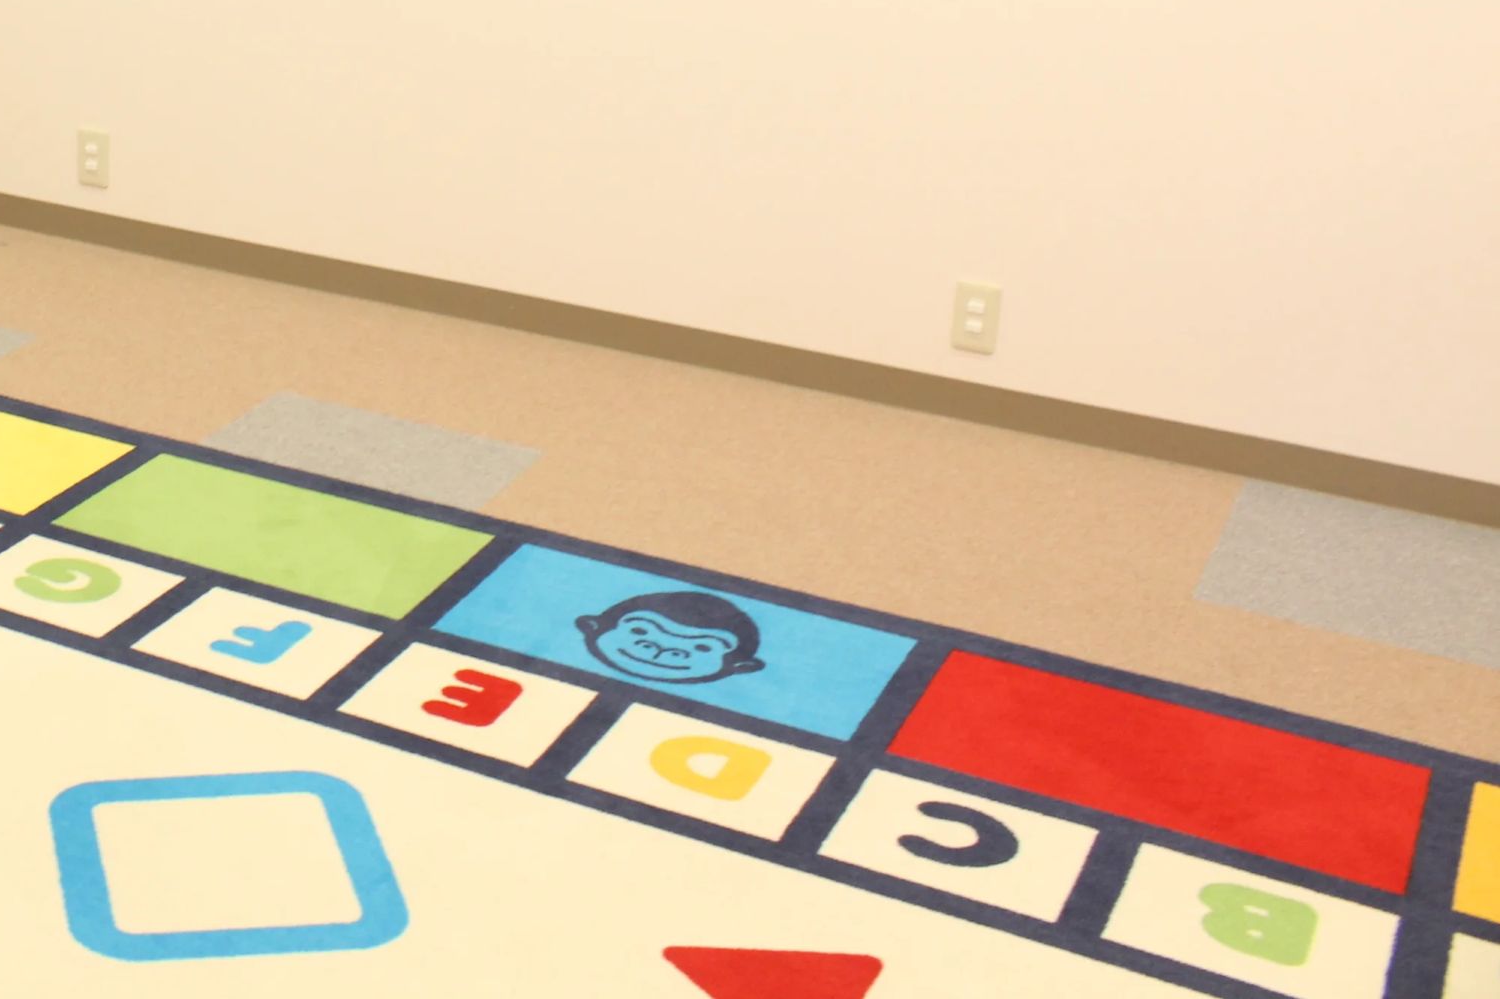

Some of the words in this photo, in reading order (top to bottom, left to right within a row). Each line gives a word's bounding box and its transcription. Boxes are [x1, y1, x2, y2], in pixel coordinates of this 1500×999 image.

[16, 558, 122, 603] G
[210, 621, 311, 664] F
[421, 669, 523, 727] E
[650, 736, 771, 801] D
[897, 801, 1020, 868] C
[1198, 882, 1318, 967] B
